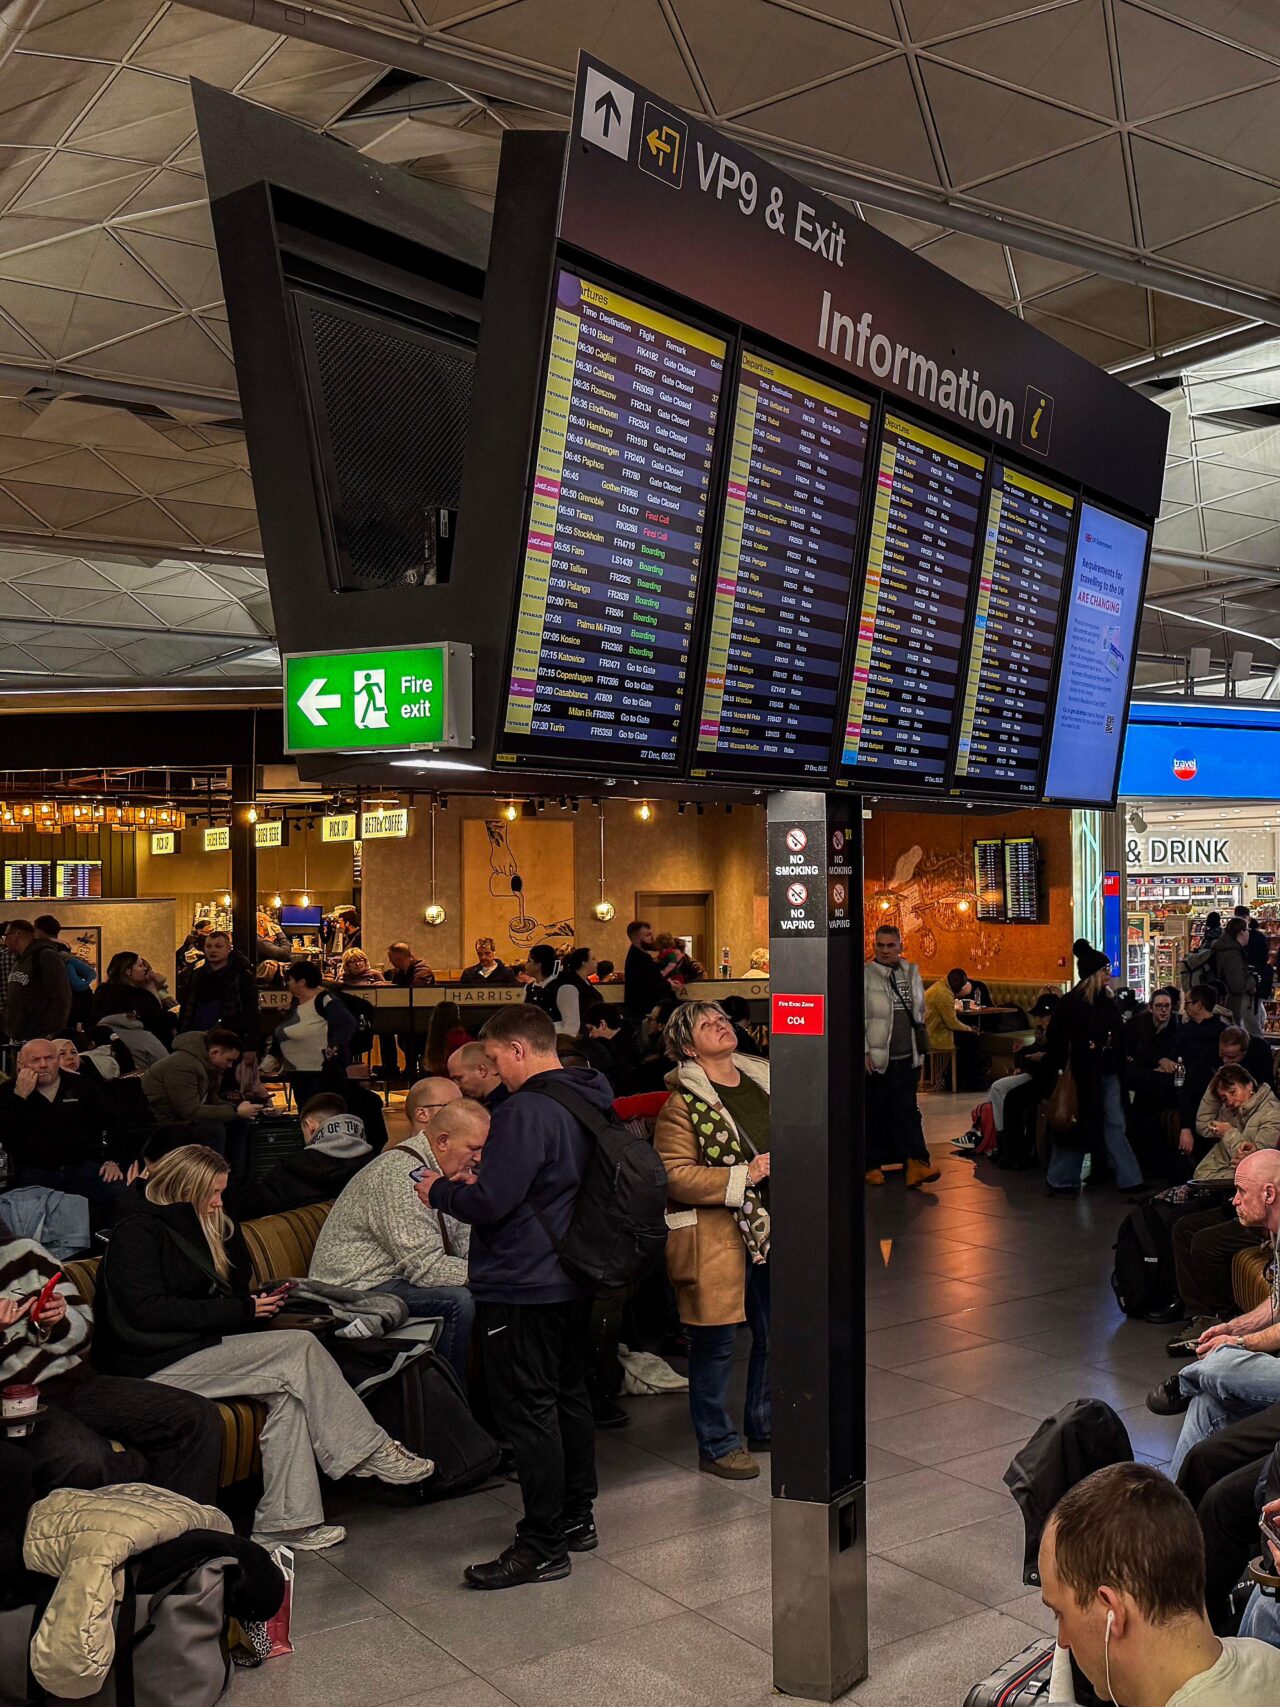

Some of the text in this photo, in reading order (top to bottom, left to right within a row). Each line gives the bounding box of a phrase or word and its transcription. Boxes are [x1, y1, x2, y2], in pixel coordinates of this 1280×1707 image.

[697, 142, 846, 268] VP9 & Exit
[582, 304, 722, 370] Time Destination Flight Remark Gate
[579, 323, 596, 337] 06:10
[597, 330, 613, 344] Basel
[663, 357, 676, 369] Gate
[677, 363, 695, 377] Closed
[575, 359, 592, 373] 06:30
[577, 341, 594, 355] 06:30
[661, 374, 674, 386] Gate
[675, 379, 693, 393] Closed
[743, 356, 774, 376] Departures
[818, 291, 1015, 439] Information
[573, 377, 590, 391] 06:35
[571, 396, 587, 409] 06:35
[588, 402, 618, 419] Eindhoven
[569, 414, 613, 438] 06:40 Hamburg
[566, 432, 583, 444] 06:45
[582, 455, 604, 469] Paphos
[562, 468, 579, 480] 06:45
[558, 504, 574, 516] 06:50
[560, 486, 577, 498] 06:50
[577, 491, 604, 506] Grenoble
[659, 514, 669, 523] Call
[553, 540, 570, 552] 06:55
[571, 545, 584, 555] Faro
[555, 522, 572, 534] 06:55
[573, 527, 604, 542] Stockholm
[641, 544, 665, 559] Boarding
[551, 558, 587, 574] 07:00 Tallinn
[1082, 558, 1115, 578] Requirements
[549, 577, 590, 594] 07:00 Palanga
[1080, 573, 1125, 596] travelling to the UK
[547, 595, 577, 608] 07:00 Pisa
[1078, 591, 1120, 613] ARE CHANGING
[542, 631, 559, 641] 07:05
[628, 645, 653, 658] Boarding
[540, 649, 557, 659] 07:15
[558, 651, 585, 663] Katowice
[626, 662, 635, 670] Go
[636, 664, 642, 672] to
[642, 665, 655, 674] Gate
[538, 667, 593, 684] 07:15 Copenhagen
[401, 676, 432, 694] Fire
[536, 685, 588, 699] 07:20 Casablanca
[401, 700, 430, 718] exit
[534, 703, 551, 712] 07:25
[531, 721, 564, 731] 07:30 Turin
[1174, 759, 1196, 768] travel
[329, 820, 348, 837] PICK UP
[365, 814, 403, 833] BETTER COFFEE
[790, 855, 804, 863] NO
[1127, 839, 1229, 863] & DRINK
[776, 866, 818, 875] SMOKING
[829, 867, 852, 875] MOKING
[791, 909, 805, 918] NO
[835, 909, 843, 917] NO
[780, 921, 815, 929] VAPING
[829, 920, 850, 928] VAPING
